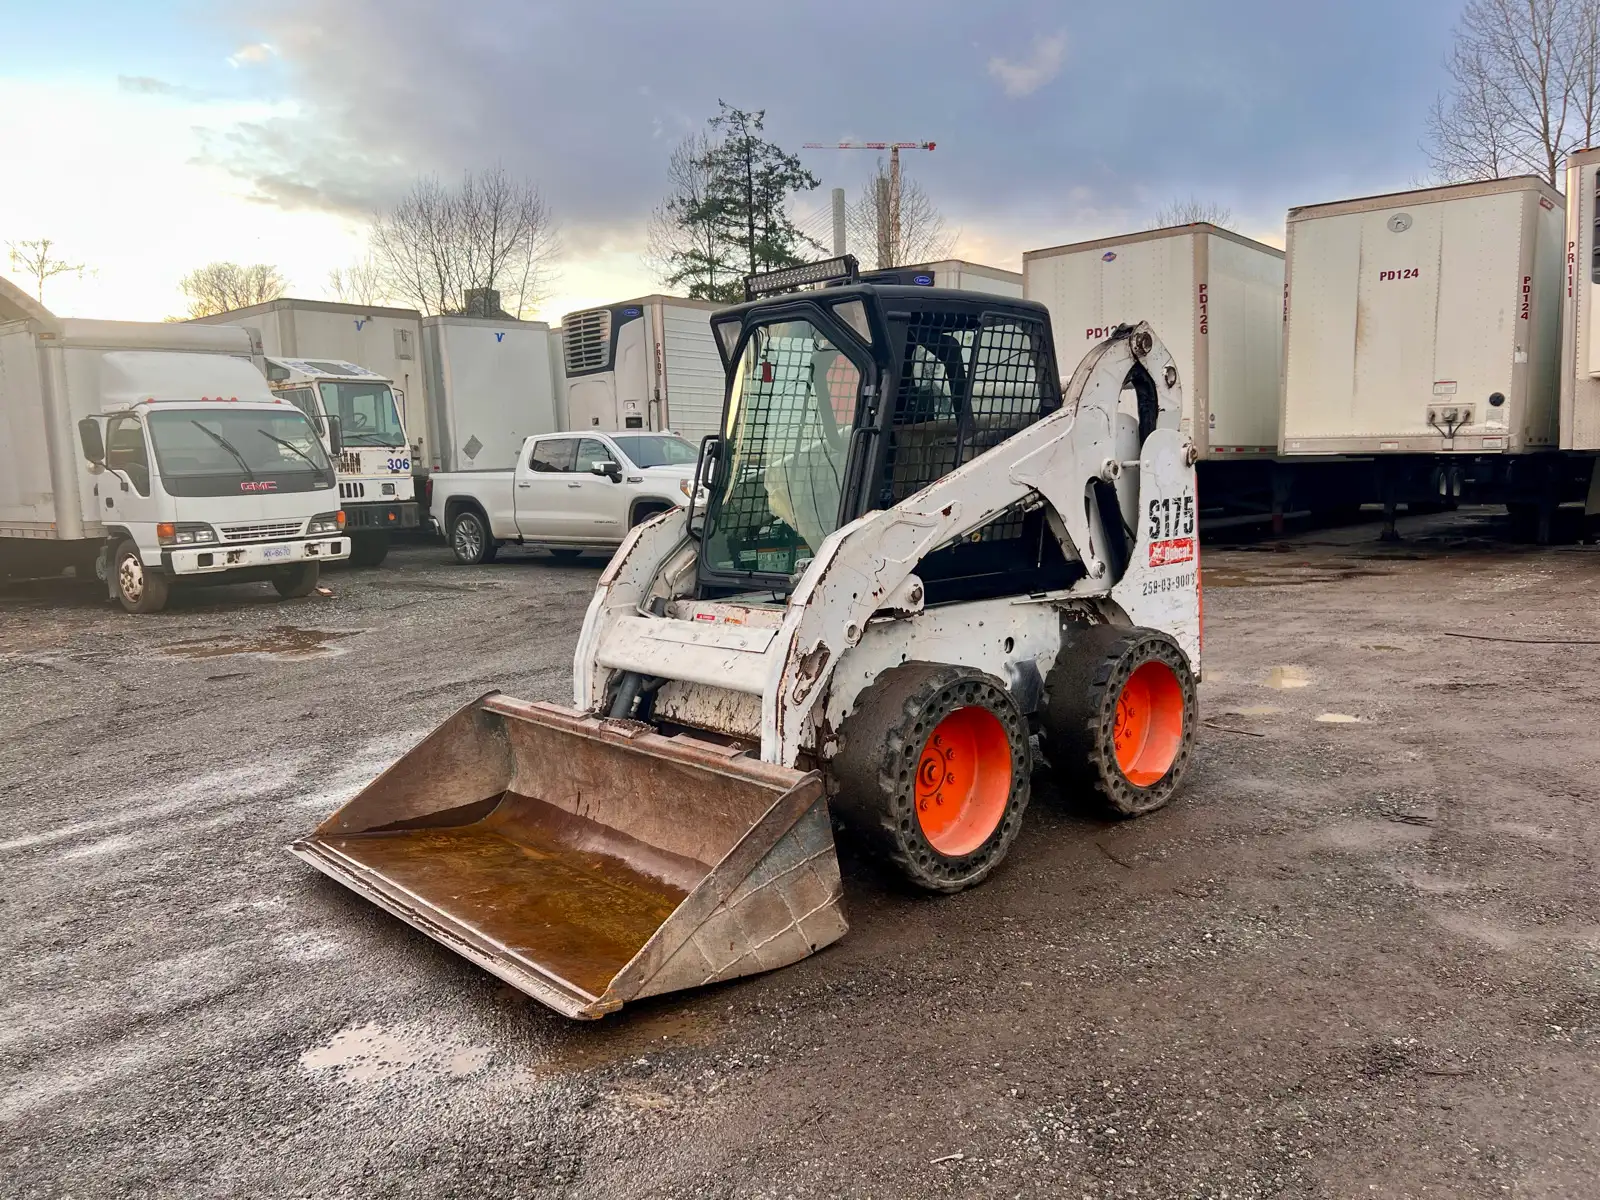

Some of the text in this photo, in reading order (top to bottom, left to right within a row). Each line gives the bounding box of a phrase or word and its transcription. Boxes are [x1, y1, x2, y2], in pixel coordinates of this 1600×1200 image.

[1380, 268, 1419, 281] PD124
[1567, 241, 1575, 298] PR111
[1199, 284, 1208, 334] PD126
[1521, 276, 1531, 320] PD124
[387, 458, 410, 470] 306
[240, 481, 277, 491] GMC
[1149, 496, 1194, 539] S175
